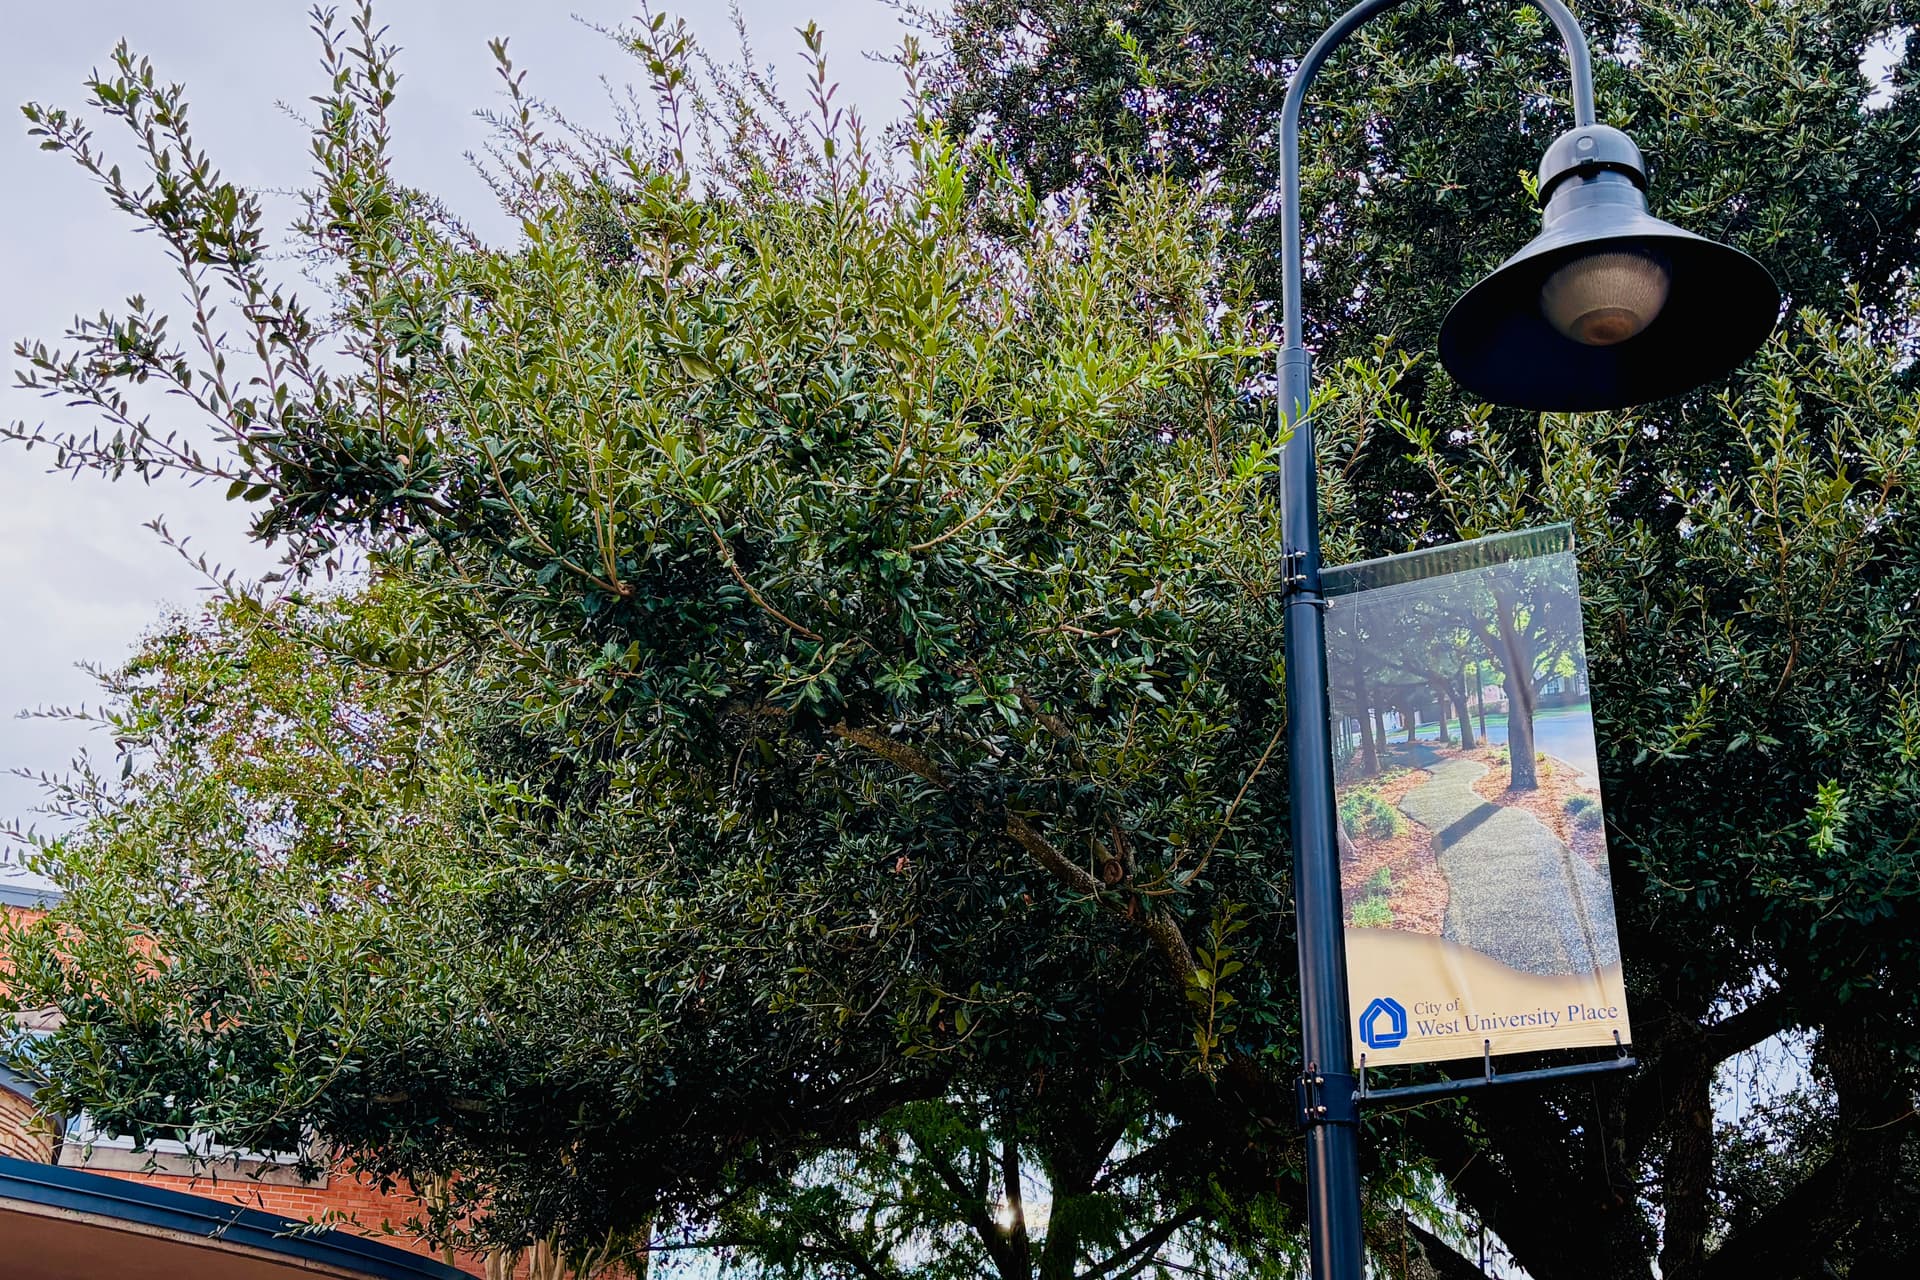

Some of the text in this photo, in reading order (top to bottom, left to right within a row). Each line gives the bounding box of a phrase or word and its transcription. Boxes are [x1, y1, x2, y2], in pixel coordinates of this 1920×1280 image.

[1414, 997, 1460, 1017] City of
[1416, 1004, 1618, 1037] West University Place
